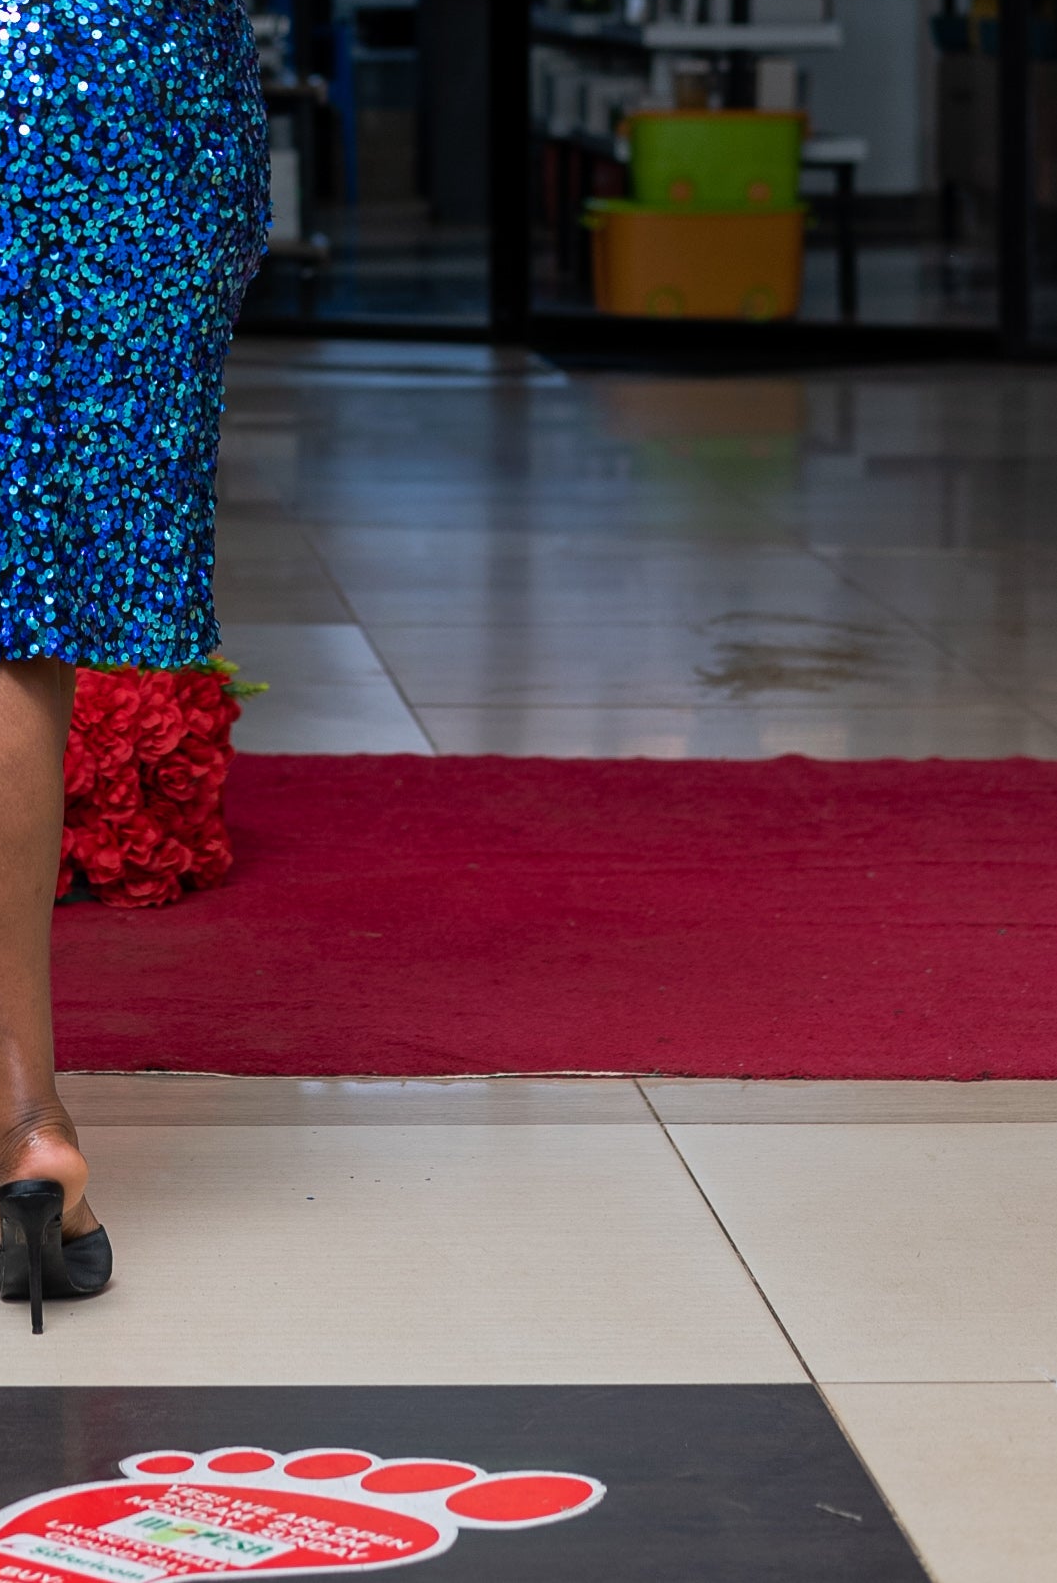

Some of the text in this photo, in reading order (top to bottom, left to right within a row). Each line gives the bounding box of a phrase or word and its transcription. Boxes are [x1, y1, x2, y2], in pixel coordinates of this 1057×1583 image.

[124, 1495, 243, 1527] MONDAY
[254, 1529, 368, 1559] SUNDAY
[231, 1499, 278, 1516] WE
[274, 1513, 335, 1529] ARE
[335, 1526, 413, 1549] OPEN
[30, 1545, 145, 1581] Safaricom
